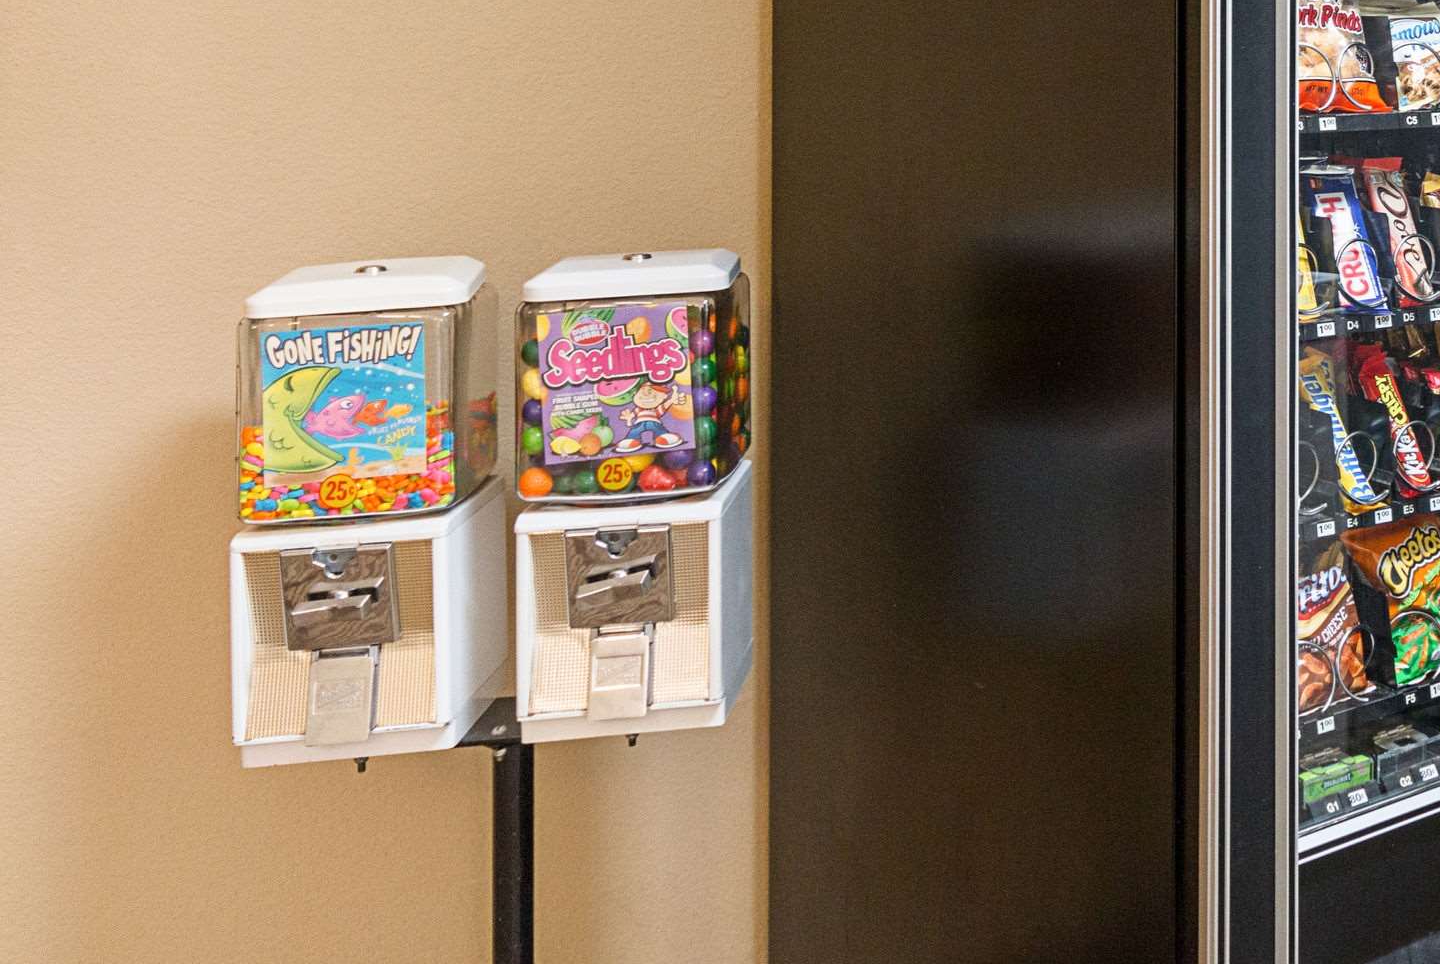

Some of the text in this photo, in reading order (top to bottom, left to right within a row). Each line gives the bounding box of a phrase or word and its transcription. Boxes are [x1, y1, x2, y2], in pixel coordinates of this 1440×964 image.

[1406, 116, 1418, 125] C5
[1318, 195, 1370, 297] CRUH
[1403, 313, 1415, 322] D5
[1346, 320, 1359, 330] D4
[265, 330, 325, 369] GONE
[544, 325, 687, 388] Seedlings
[1374, 373, 1408, 425] CRISPY
[1403, 505, 1414, 514] E5
[1347, 517, 1359, 527] E4
[1322, 606, 1347, 644] CHEESE
[1405, 694, 1416, 704] F5
[1400, 776, 1413, 787] G2
[1326, 801, 1339, 813] G1
